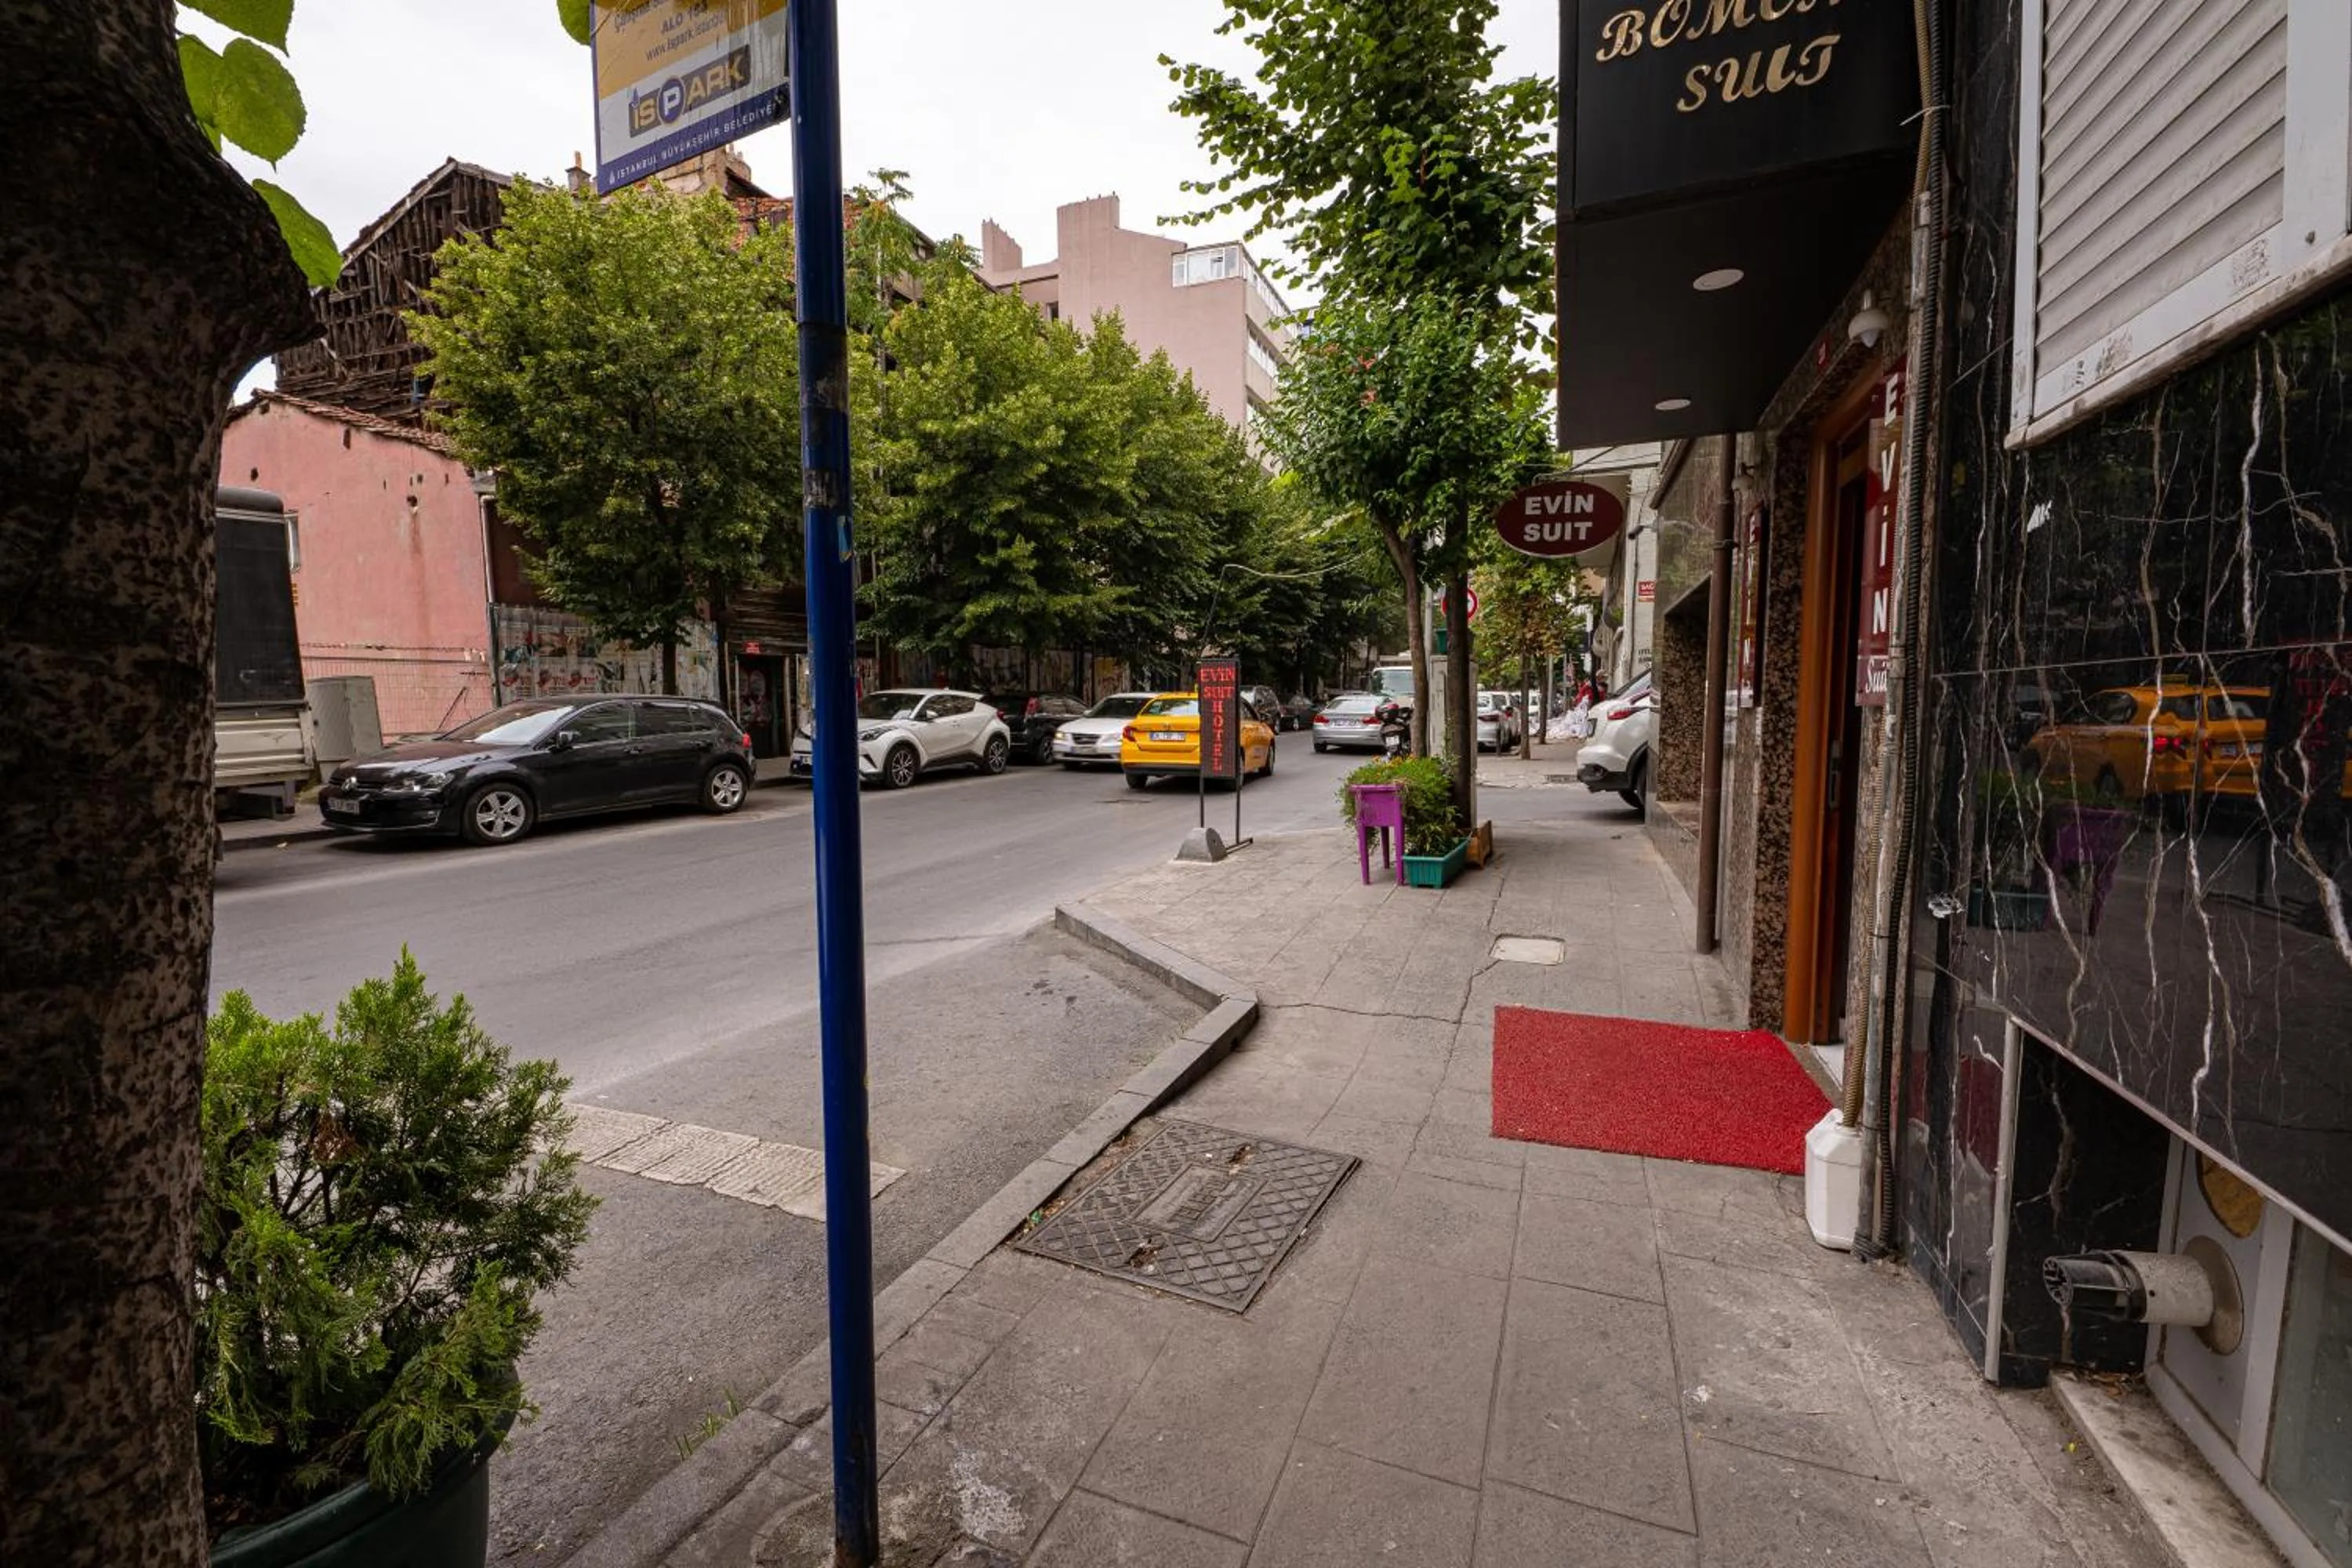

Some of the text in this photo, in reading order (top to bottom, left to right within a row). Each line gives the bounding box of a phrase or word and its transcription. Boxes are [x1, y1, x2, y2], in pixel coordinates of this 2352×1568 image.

[1596, 0, 1840, 62] BOM
[1524, 490, 1595, 516] EVİN
[1523, 521, 1594, 542] SUIT
